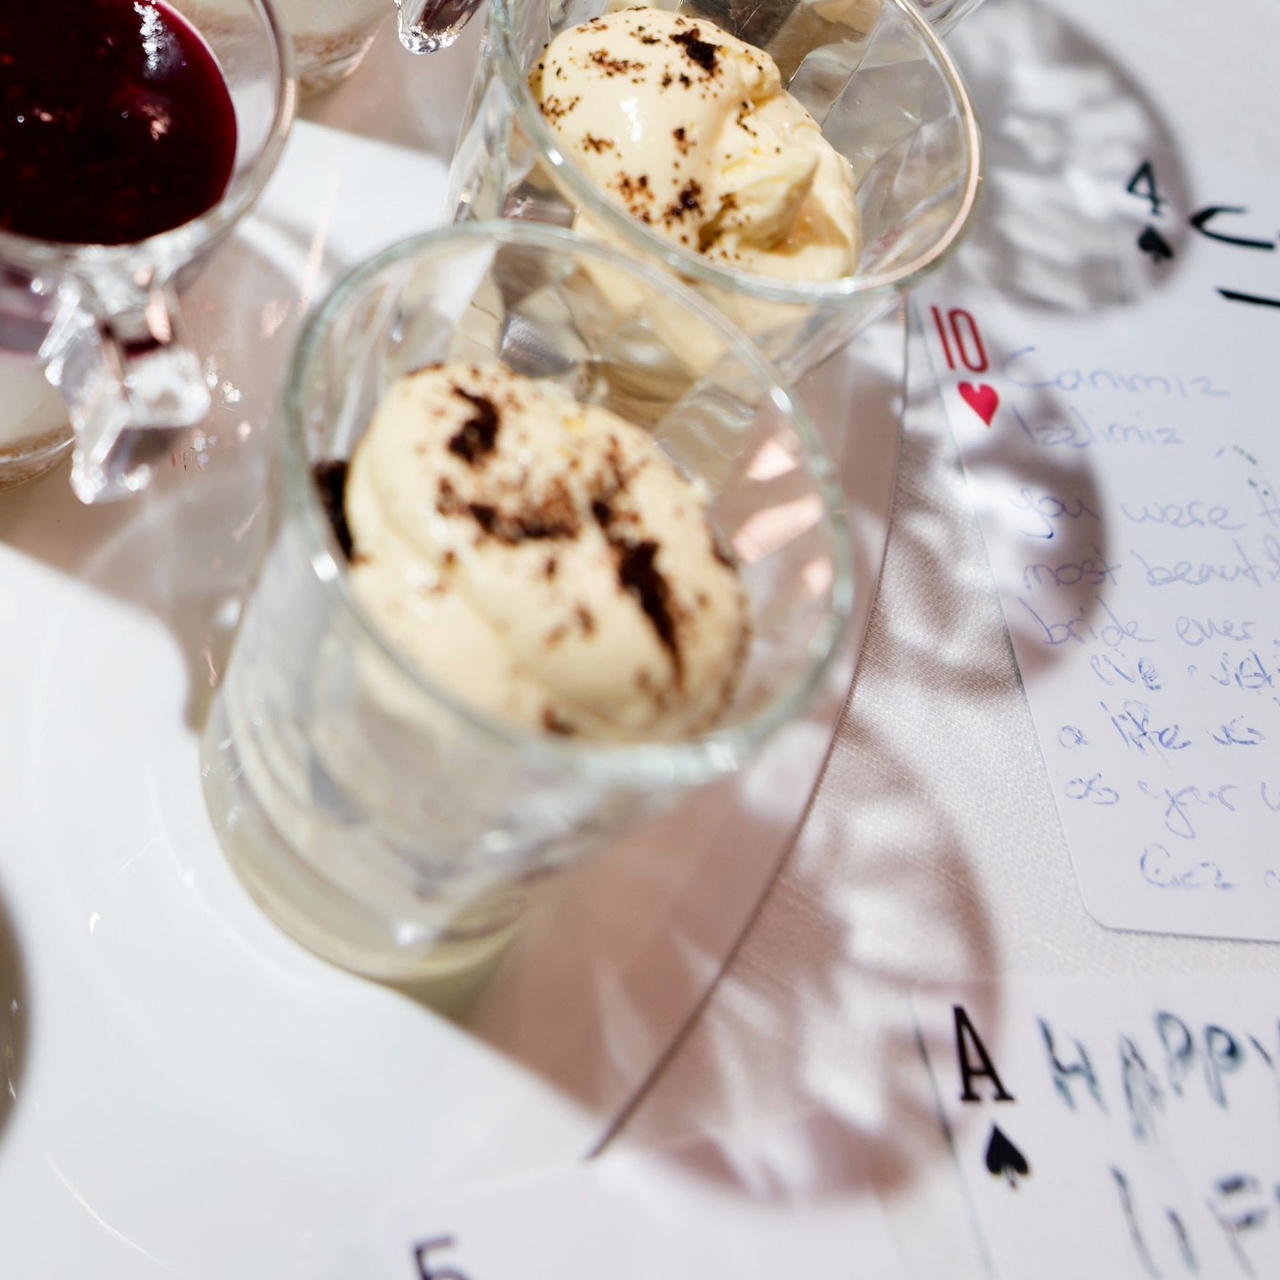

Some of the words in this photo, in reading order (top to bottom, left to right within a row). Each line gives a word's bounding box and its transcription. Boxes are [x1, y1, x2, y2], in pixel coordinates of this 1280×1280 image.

[1127, 159, 1166, 216] 4
[931, 306, 990, 372] 10
[1120, 500, 1247, 531] were
[1023, 543, 1121, 590] most
[1018, 595, 1156, 646] bride
[953, 1003, 1016, 1103] A
